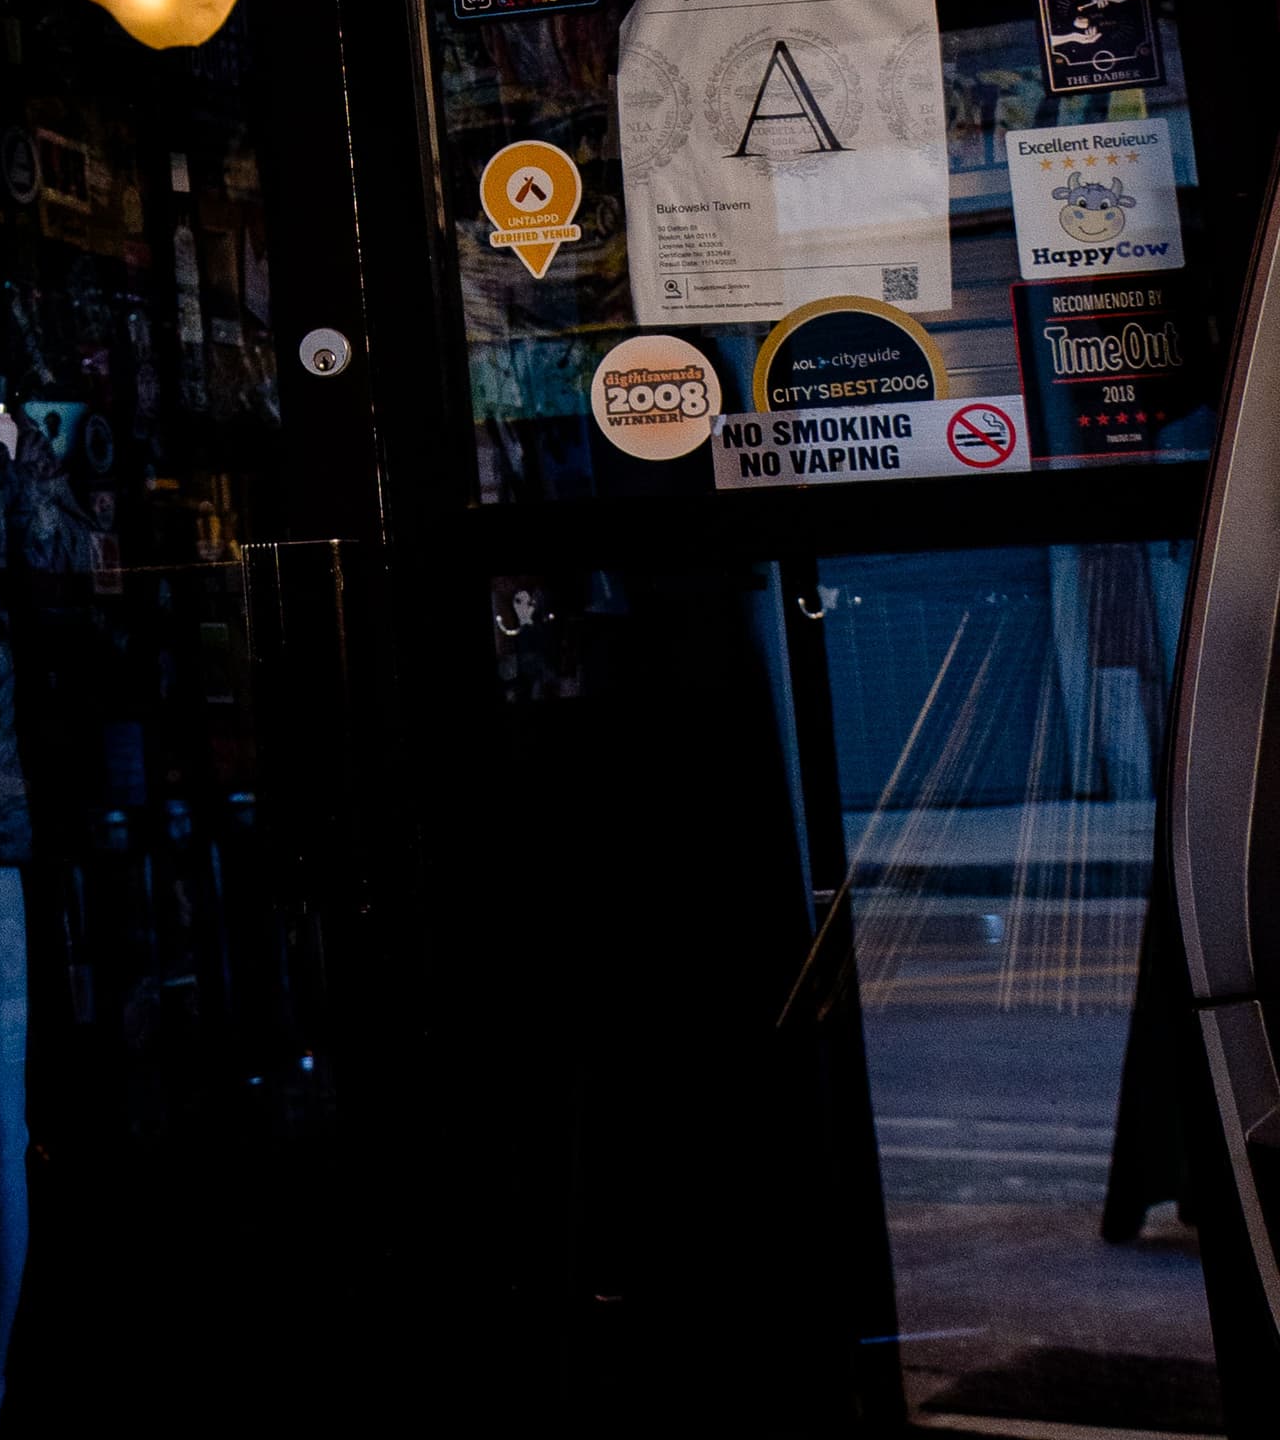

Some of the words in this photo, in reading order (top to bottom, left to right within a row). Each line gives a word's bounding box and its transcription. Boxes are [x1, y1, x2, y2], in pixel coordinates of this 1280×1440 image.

[722, 40, 856, 159] A
[1017, 136, 1090, 157] Excellent
[1094, 129, 1159, 150] Reviews
[508, 213, 559, 227] UNTAPPD
[656, 202, 710, 214] Bukowski
[714, 201, 751, 212] Tavern
[493, 230, 538, 244] VERIFIED
[543, 227, 576, 240] VENUE
[1032, 240, 1169, 269] HappyCow
[1052, 292, 1144, 314] RECOMMENDED
[1147, 289, 1163, 308] BY
[792, 359, 817, 371] AOL
[830, 347, 900, 369] cityguide
[606, 382, 709, 418] 2008
[1101, 385, 1135, 404] 2018
[608, 410, 685, 427] WINNER!
[723, 420, 762, 449] NO
[774, 414, 912, 446] SMOKING
[740, 451, 778, 477] NO
[790, 445, 900, 473] VAPING
